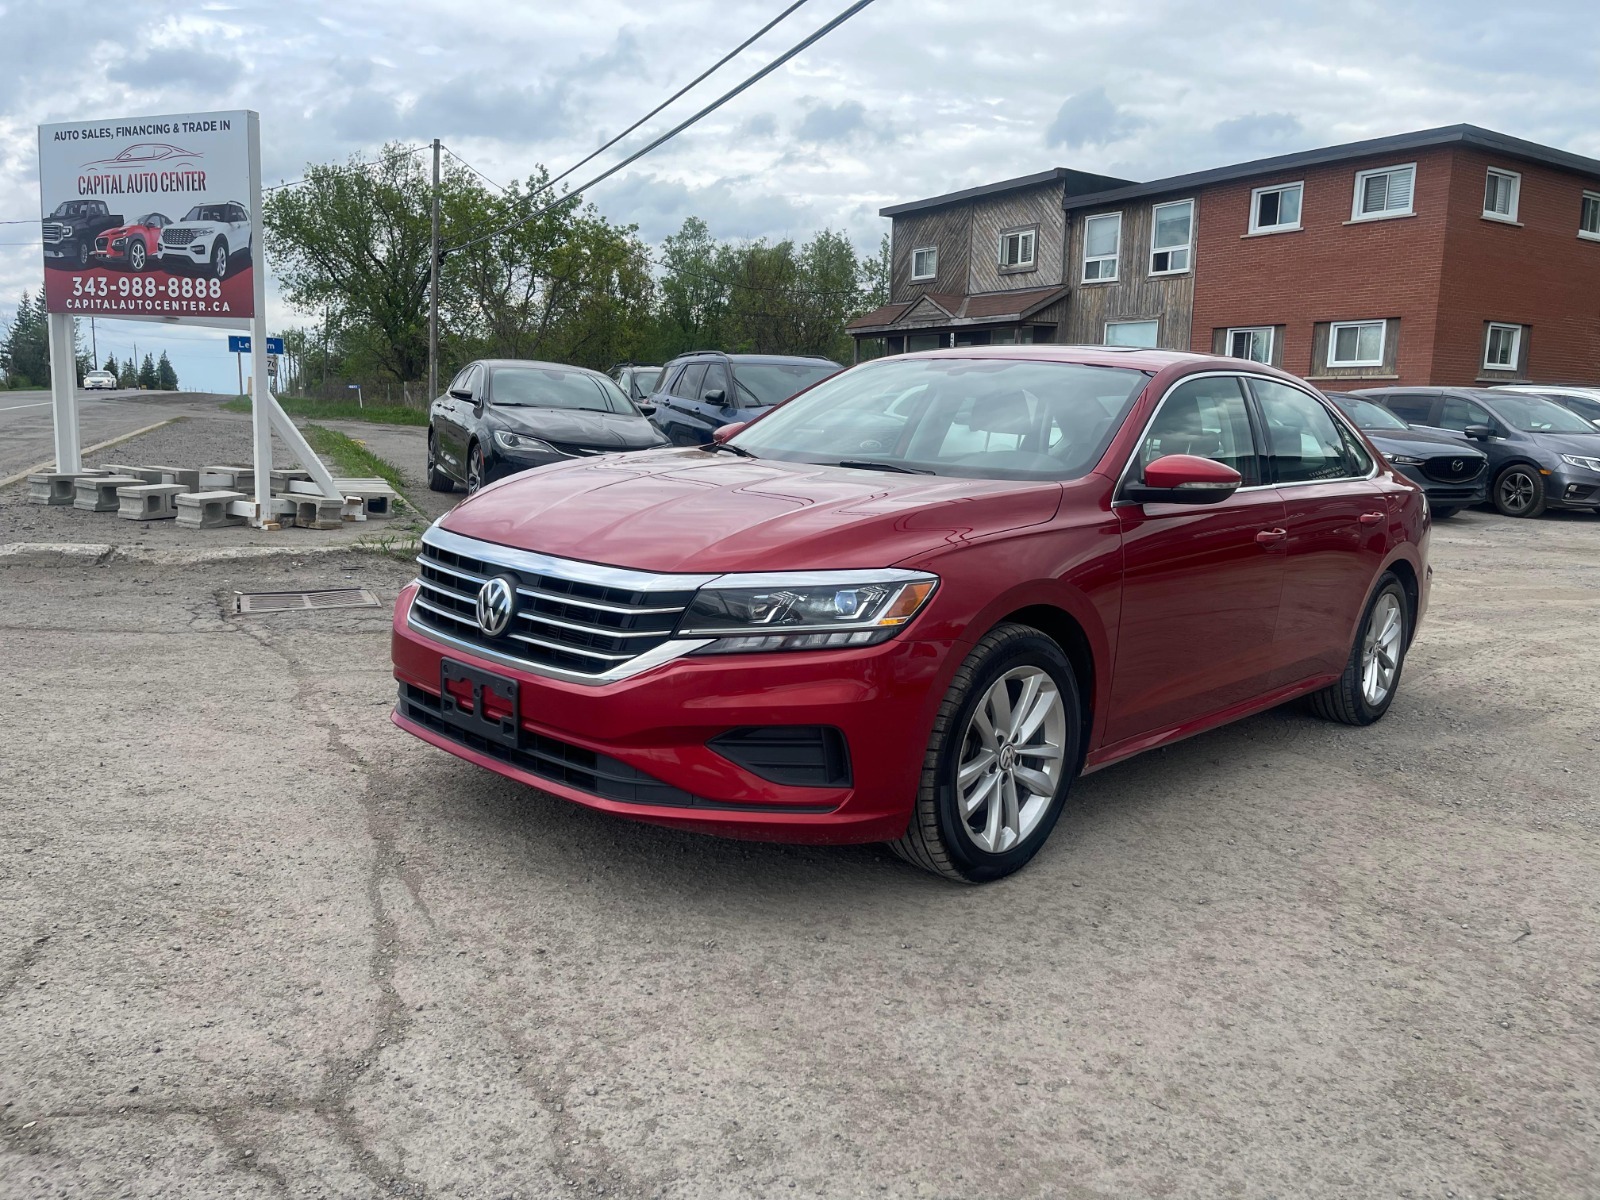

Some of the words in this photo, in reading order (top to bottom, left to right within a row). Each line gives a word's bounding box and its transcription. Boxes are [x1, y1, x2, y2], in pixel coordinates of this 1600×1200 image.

[54, 130, 79, 141] AUTO
[81, 128, 114, 139] SALES,
[116, 123, 170, 137] FINANCING
[172, 123, 179, 133] &
[182, 121, 217, 133] TRADE
[219, 119, 231, 131] IN
[78, 174, 125, 195] CAPITAL
[126, 172, 158, 194] AUTO
[160, 171, 206, 192] CENTER
[72, 276, 221, 298] 343-988-8888
[66, 299, 231, 312] CAPITALAUTOCENTER.CA
